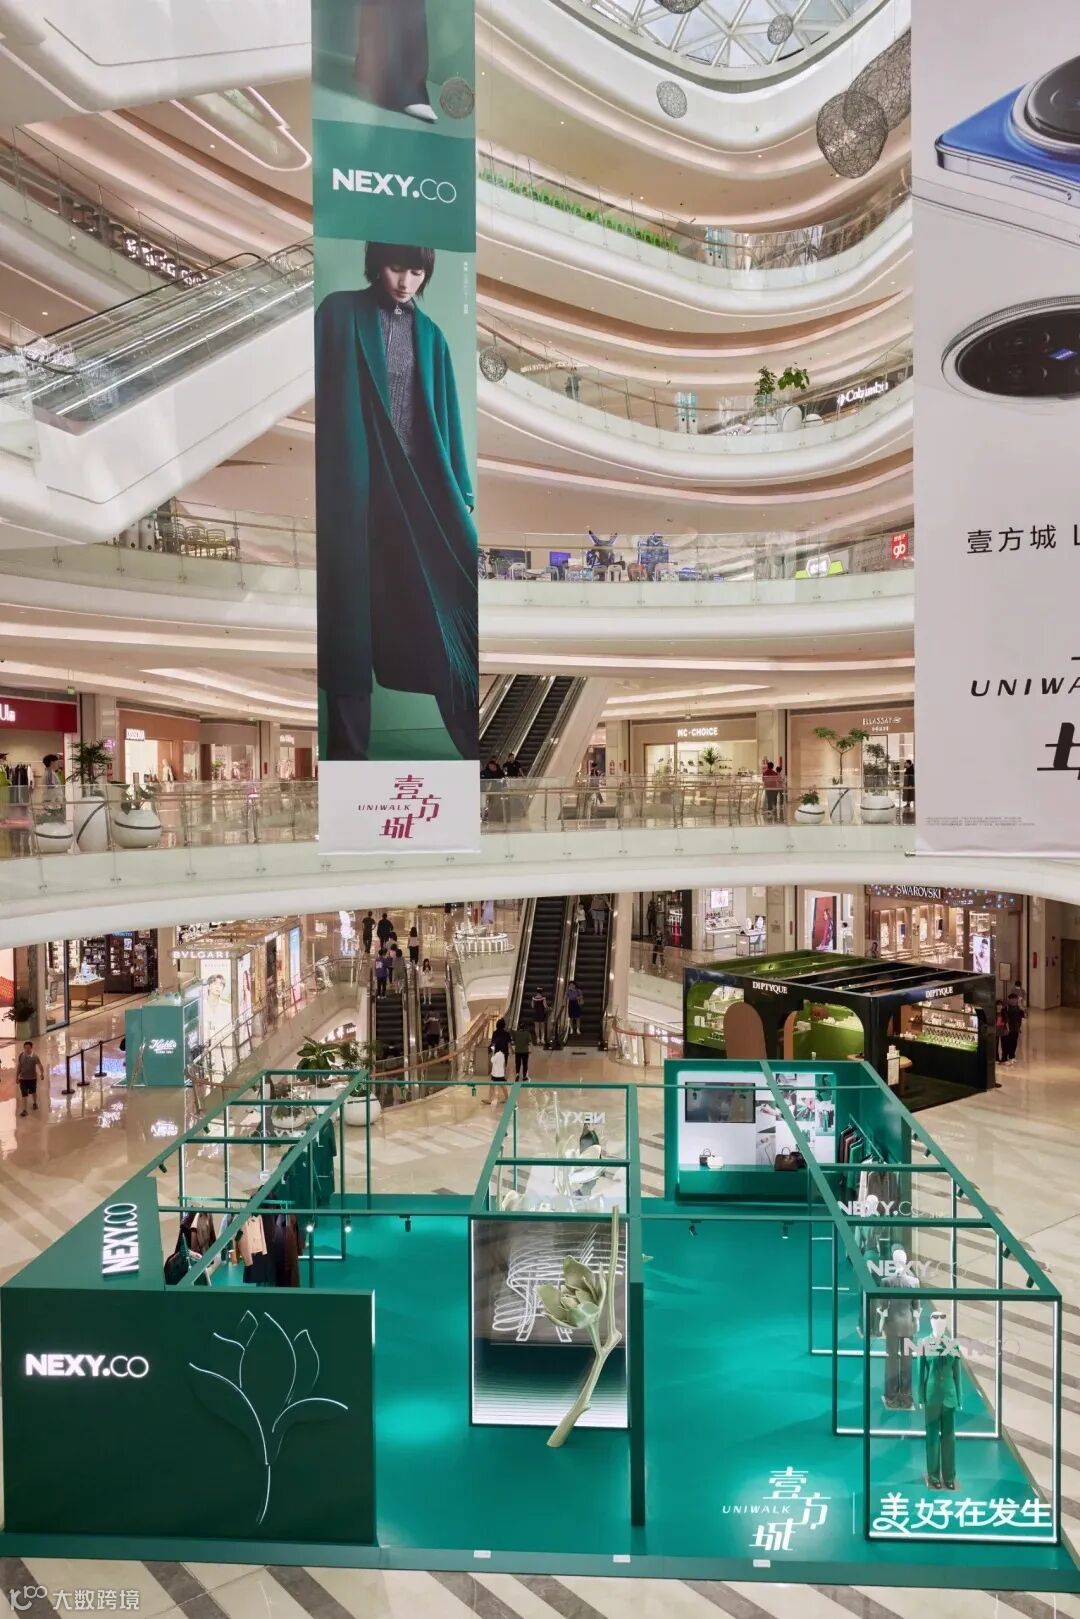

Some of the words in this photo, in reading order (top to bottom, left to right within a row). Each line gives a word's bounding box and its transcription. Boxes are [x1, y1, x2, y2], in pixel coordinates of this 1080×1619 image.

[332, 168, 457, 203] NEXY.CO
[966, 524, 1057, 553] 壹方城
[896, 884, 941, 899] SWAROVSKI
[172, 950, 229, 959] BVLGARI
[752, 981, 788, 994] DIPTYQUE
[925, 986, 953, 998] DIPTYQUE
[102, 1203, 139, 1273] NEXY.CO
[25, 1353, 150, 1378] NEXY.CO
[722, 1504, 791, 1515] UNIWALK
[872, 1492, 1053, 1534] 美好在发生
